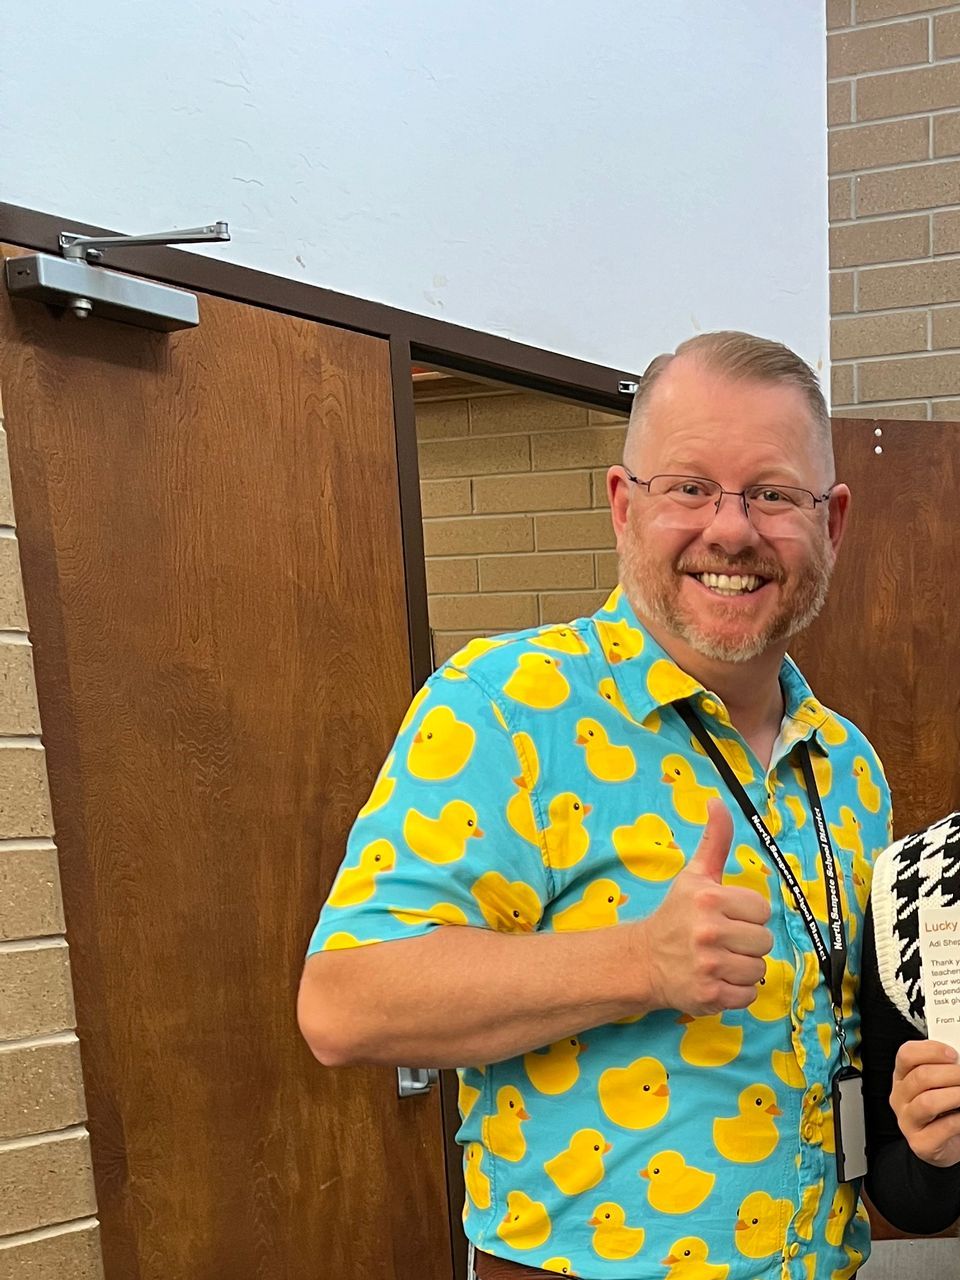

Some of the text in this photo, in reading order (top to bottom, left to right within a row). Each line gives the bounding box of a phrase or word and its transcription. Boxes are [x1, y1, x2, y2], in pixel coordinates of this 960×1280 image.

[814, 807, 843, 950] North Sanpete School District
[751, 814, 827, 961] North Sanpete School District
[924, 920, 958, 932] Lucky
[928, 940, 941, 948] Adi
[931, 959, 954, 967] Thank
[932, 980, 949, 988] your
[934, 998, 950, 1006] task
[935, 1017, 955, 1025] From
